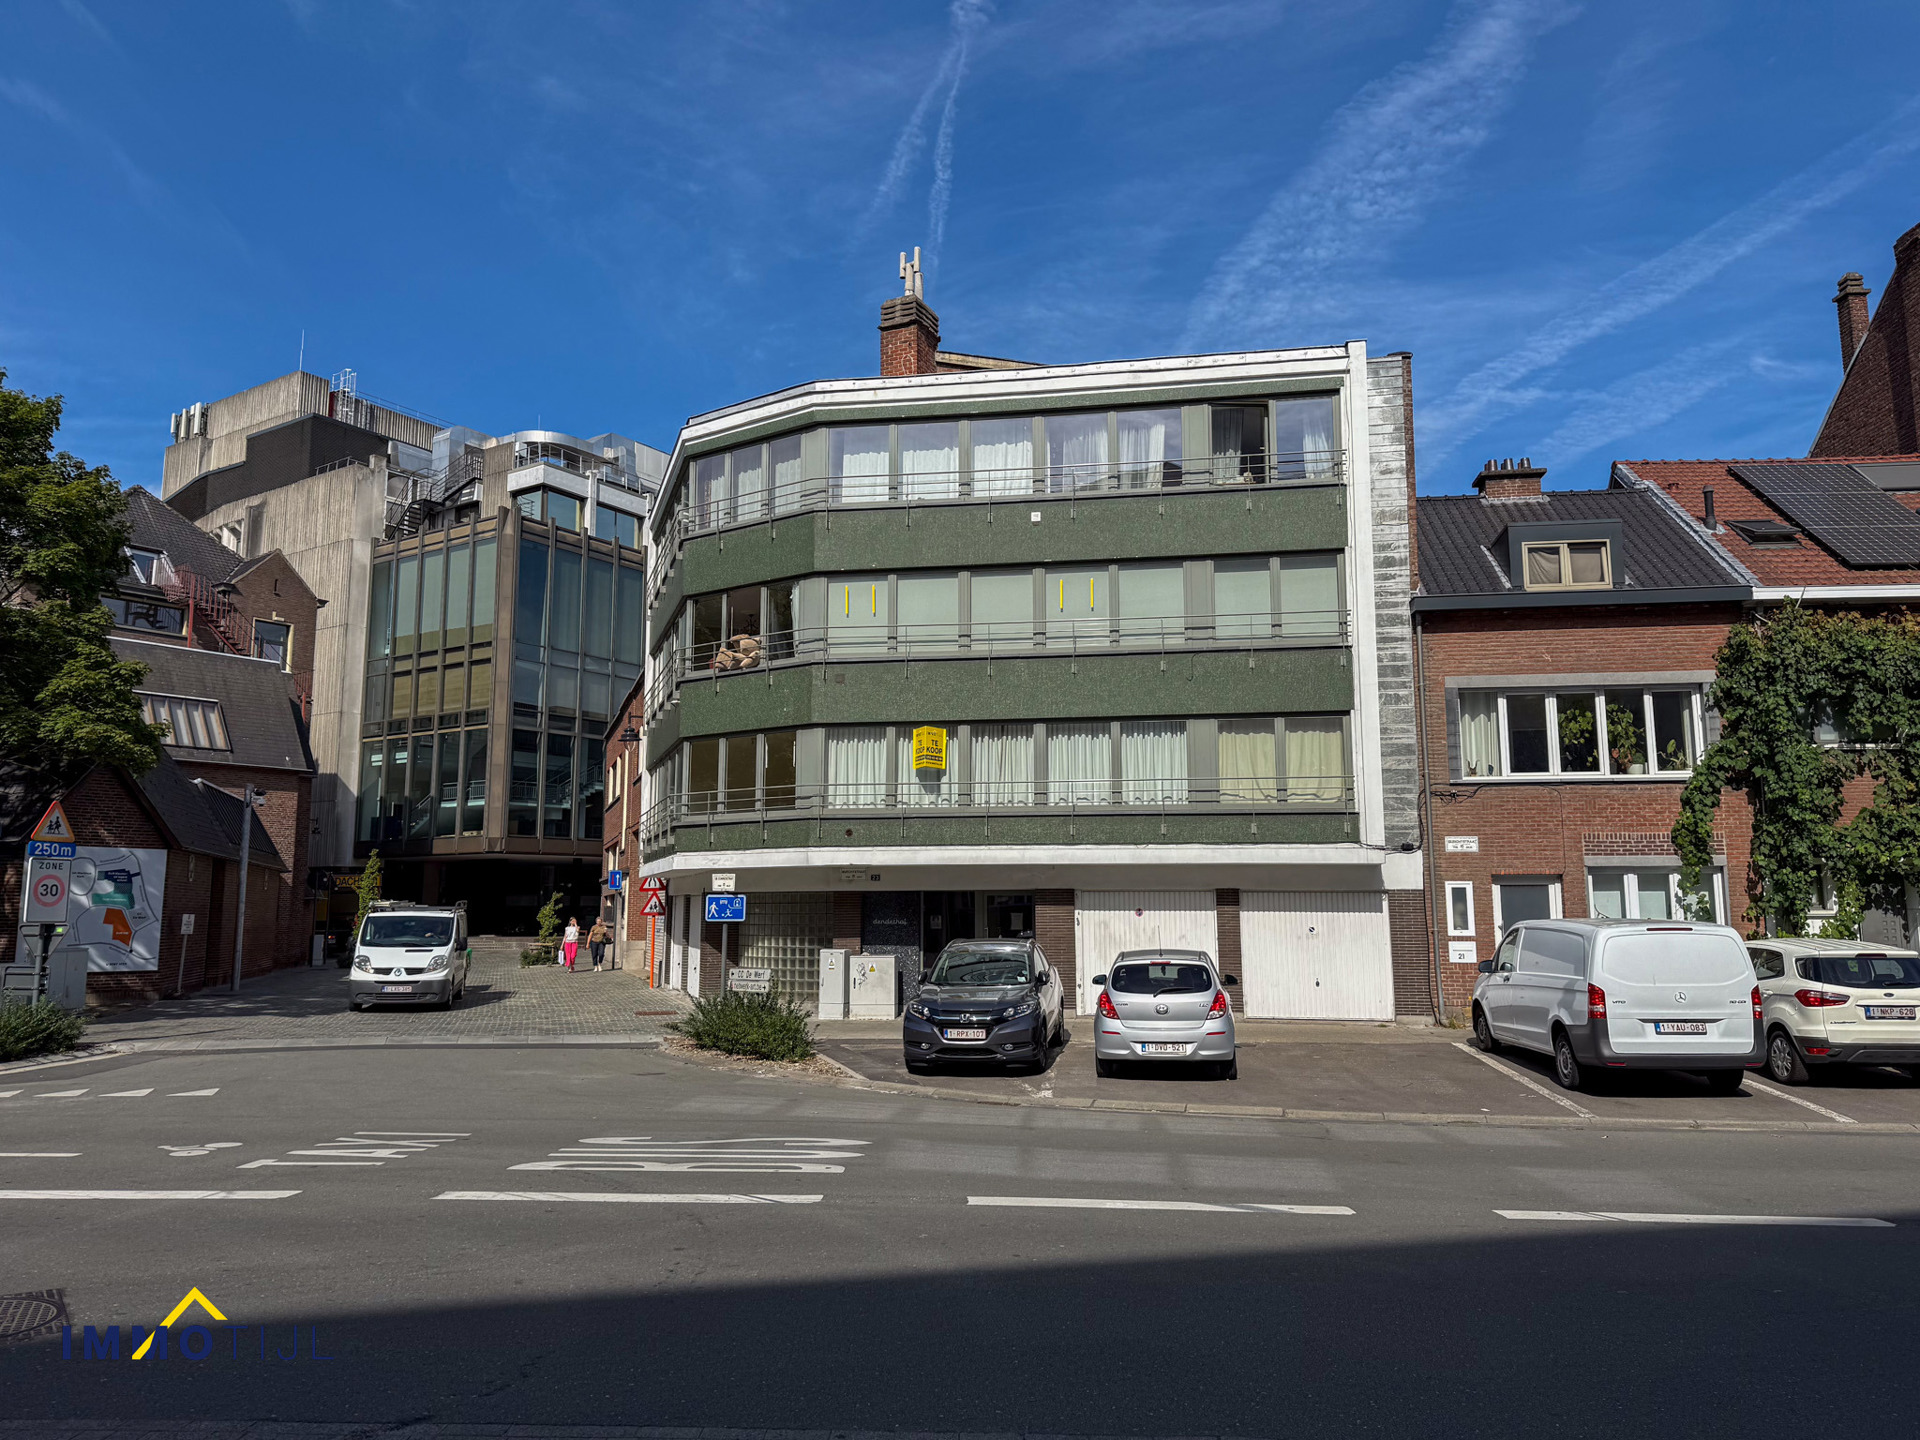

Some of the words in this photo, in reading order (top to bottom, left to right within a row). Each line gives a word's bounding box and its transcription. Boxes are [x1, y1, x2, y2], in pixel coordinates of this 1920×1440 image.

[926, 746, 942, 754] KOOP
[39, 862, 64, 870] ZONE
[40, 884, 58, 896] 30
[738, 970, 744, 978] CC
[746, 970, 752, 978] De
[754, 970, 766, 979] Werf
[1872, 1008, 1914, 1016] 1-NKP-628
[236, 1131, 472, 1169] TAXI
[506, 1136, 874, 1174] BUS
